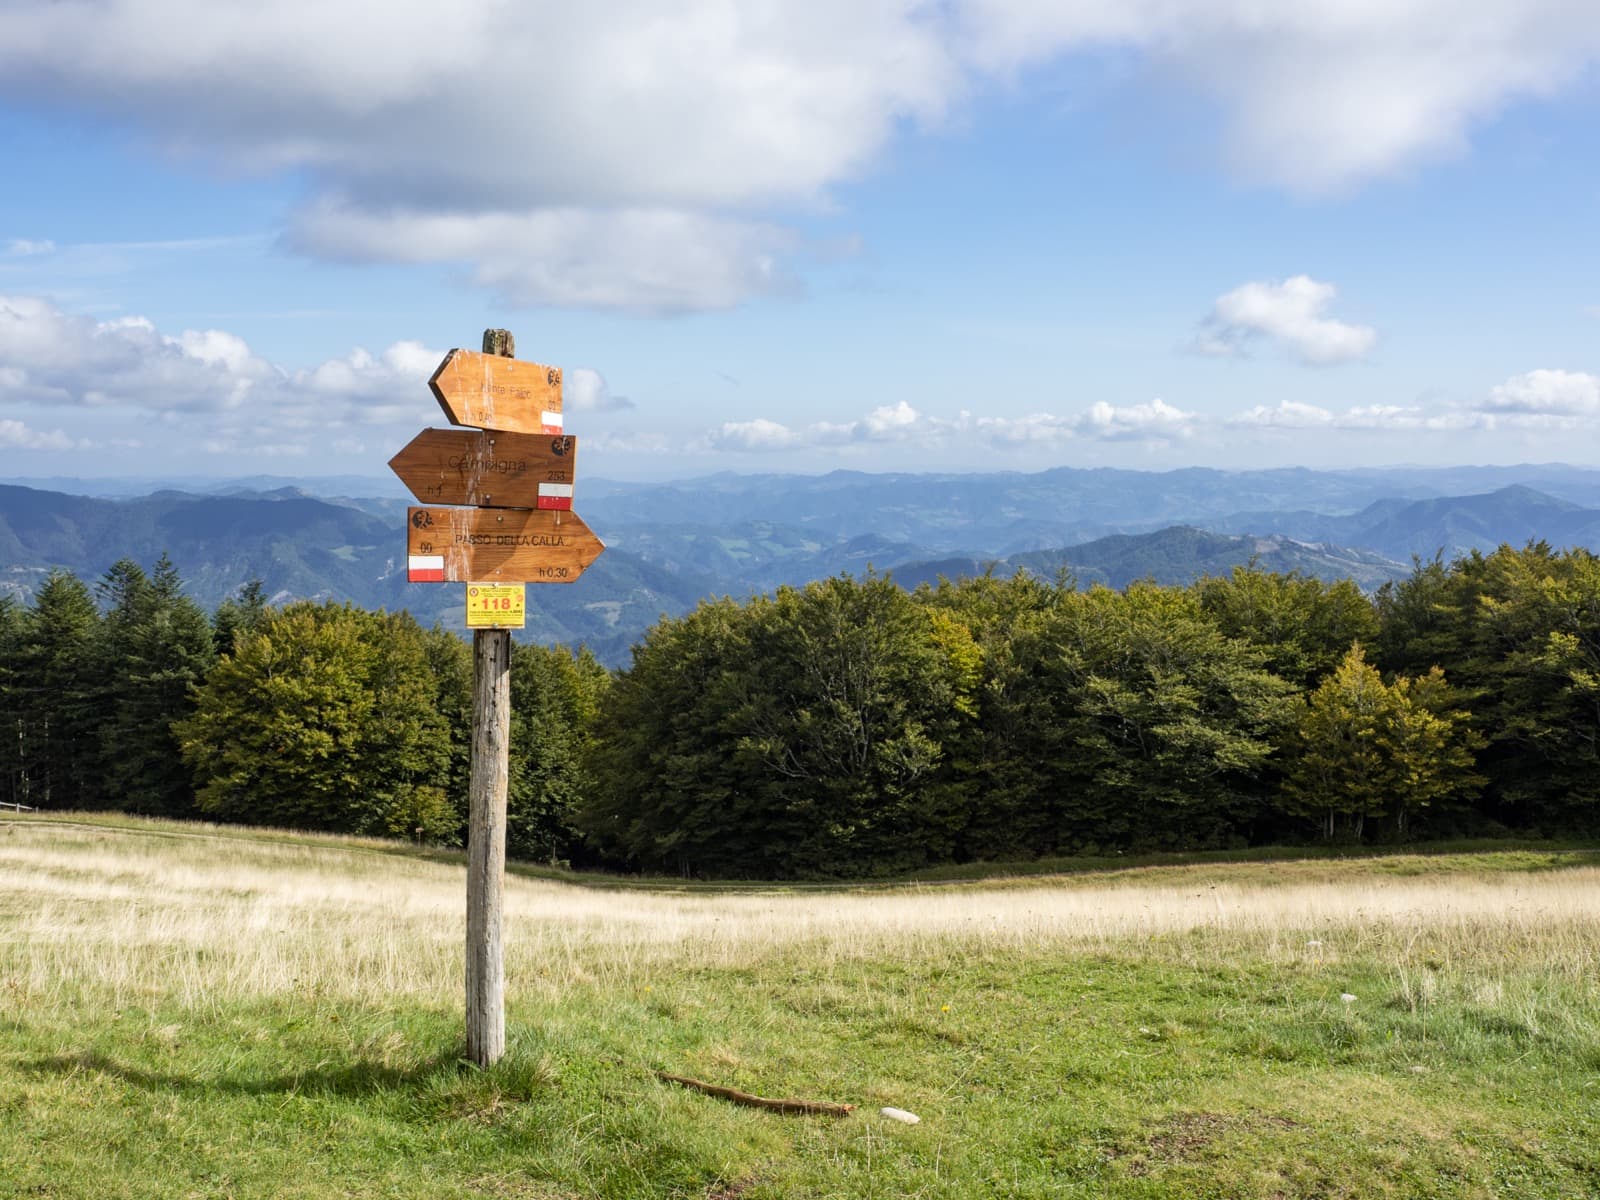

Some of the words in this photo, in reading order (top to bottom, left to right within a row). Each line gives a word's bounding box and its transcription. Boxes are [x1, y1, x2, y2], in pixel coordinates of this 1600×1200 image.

[447, 455, 528, 474] Campigna
[455, 533, 491, 546] PASSO
[496, 535, 530, 546] DELLA
[531, 535, 565, 547] CALLA
[481, 598, 511, 610] 118
